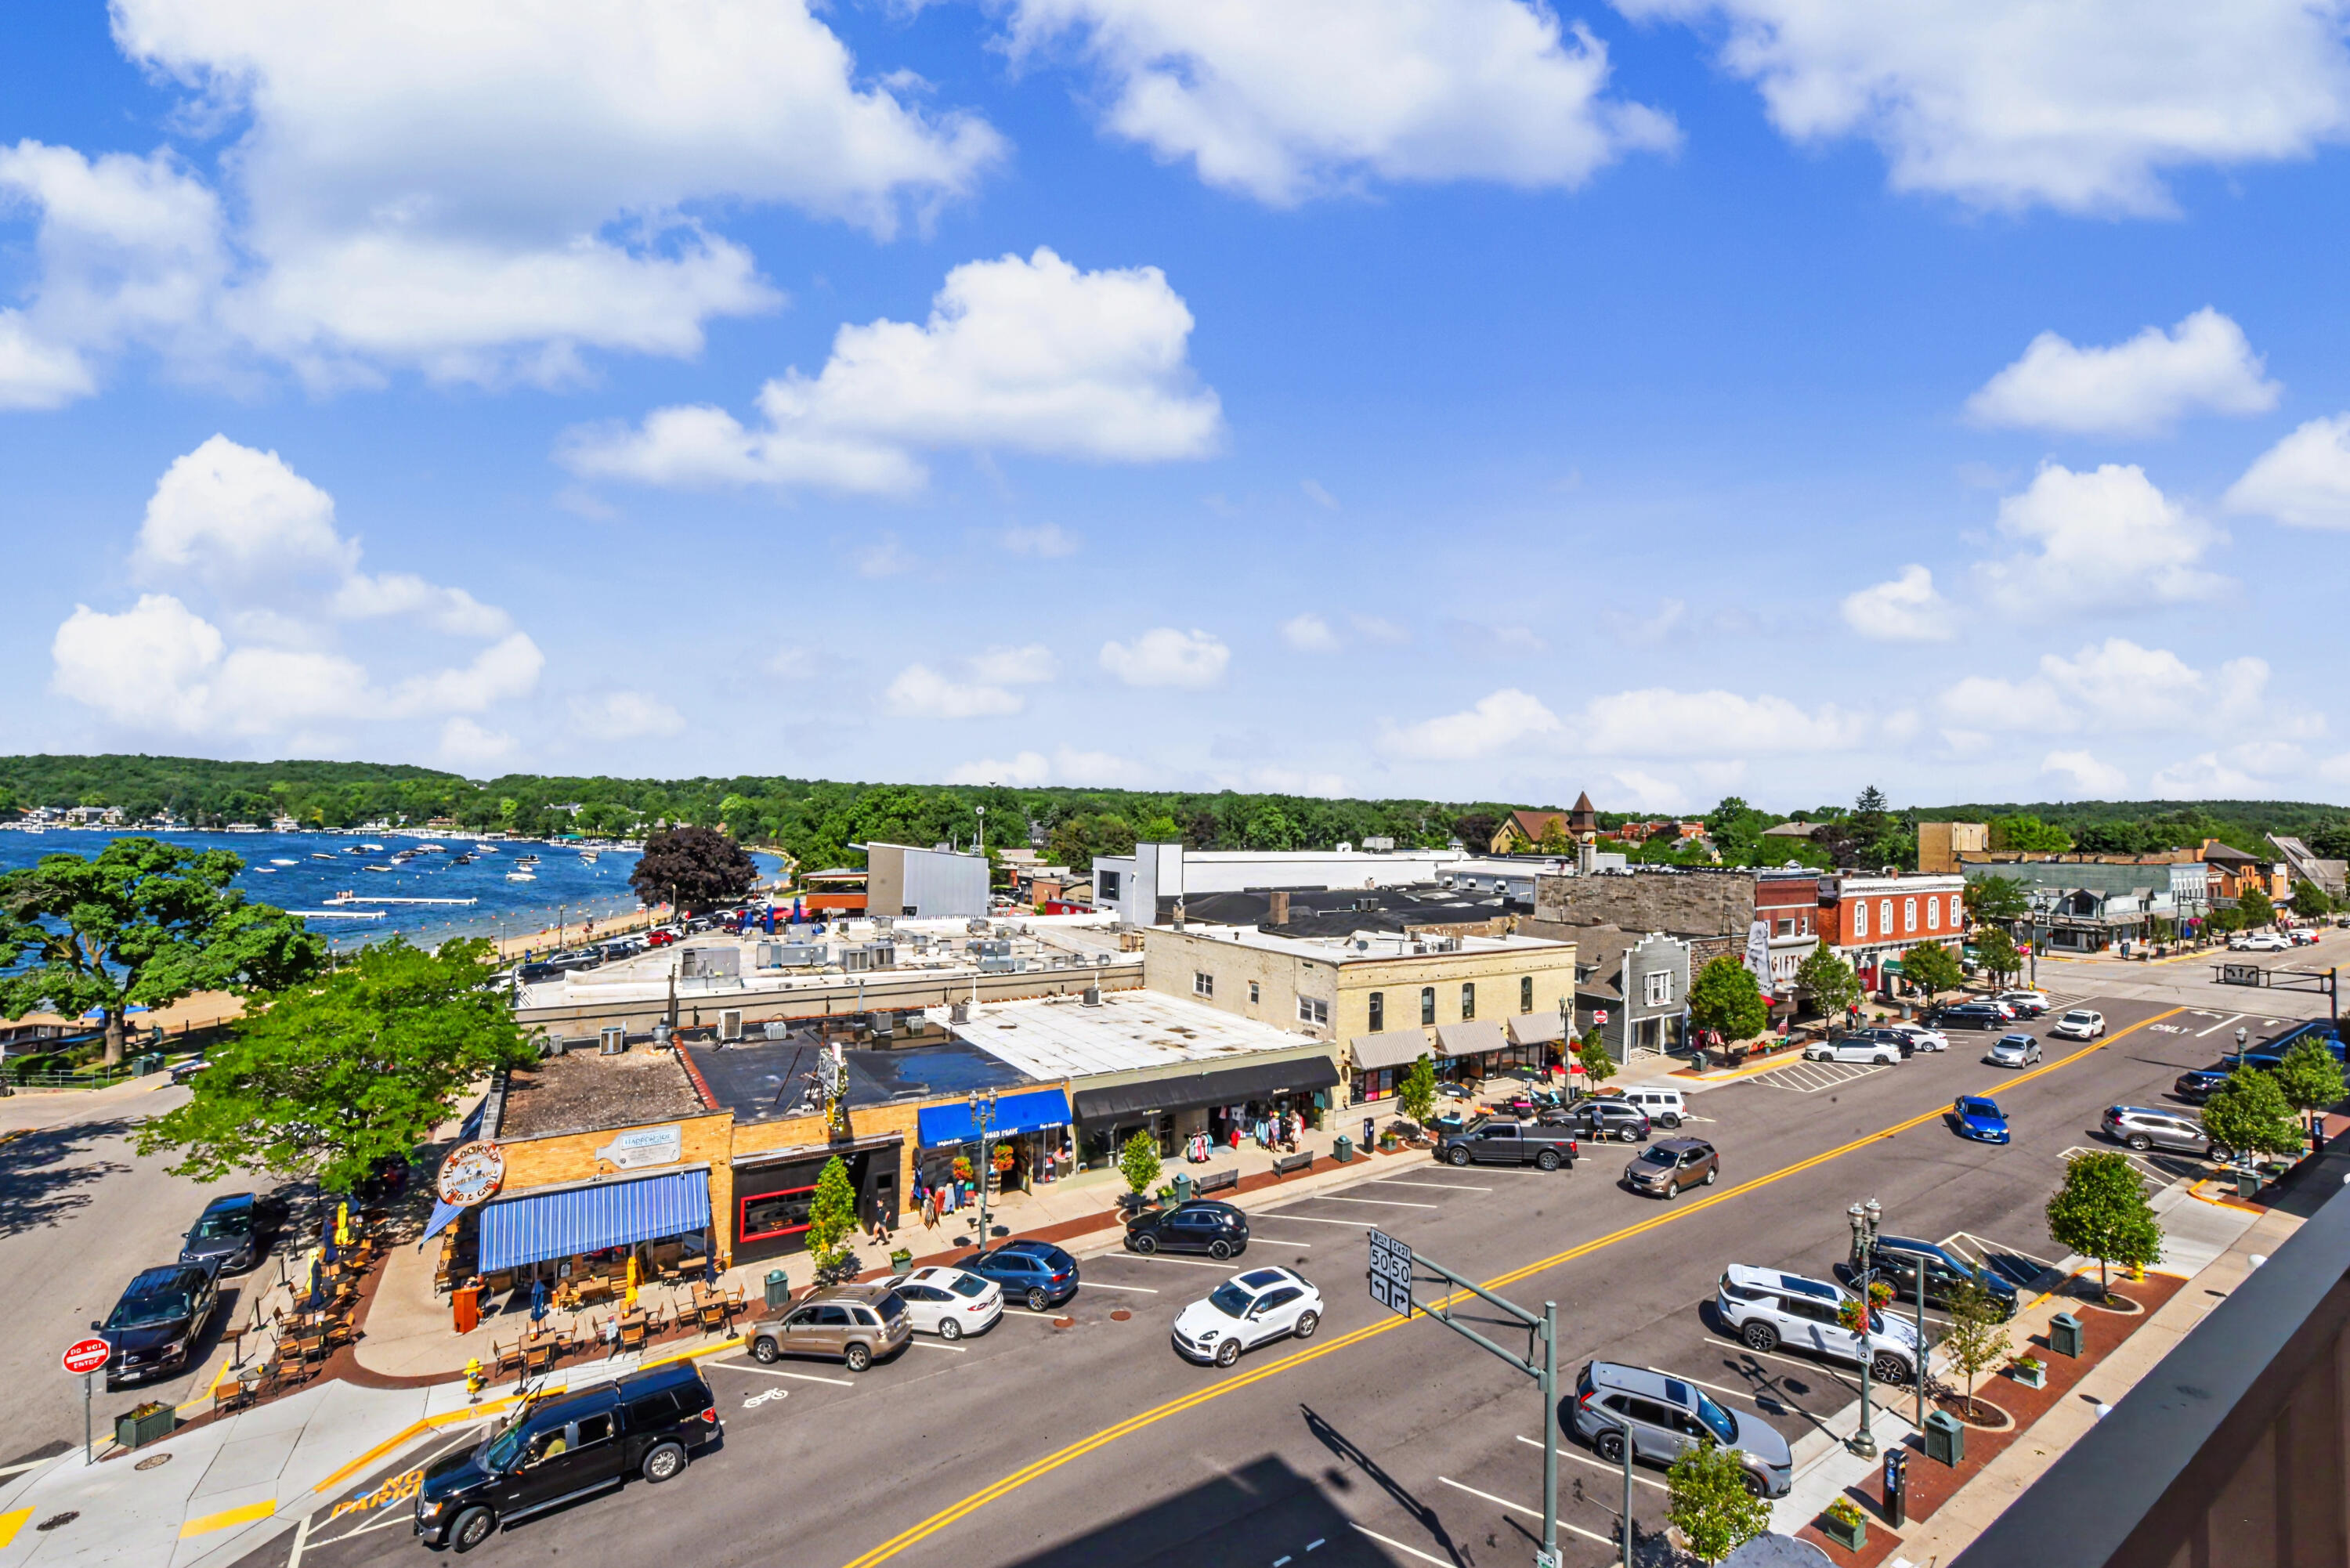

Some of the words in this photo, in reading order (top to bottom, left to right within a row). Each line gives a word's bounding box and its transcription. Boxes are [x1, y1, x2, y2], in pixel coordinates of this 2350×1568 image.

[2149, 1024, 2193, 1035] ONLY
[1373, 1230, 1387, 1246] WEST
[1394, 1242, 1408, 1258] EAST
[1372, 1249, 1388, 1270] 50
[1392, 1261, 1409, 1283] 50
[87, 1342, 102, 1351] NOT
[74, 1357, 99, 1369] ENTER
[382, 1470, 424, 1491] NO
[331, 1481, 421, 1519] PARKI
